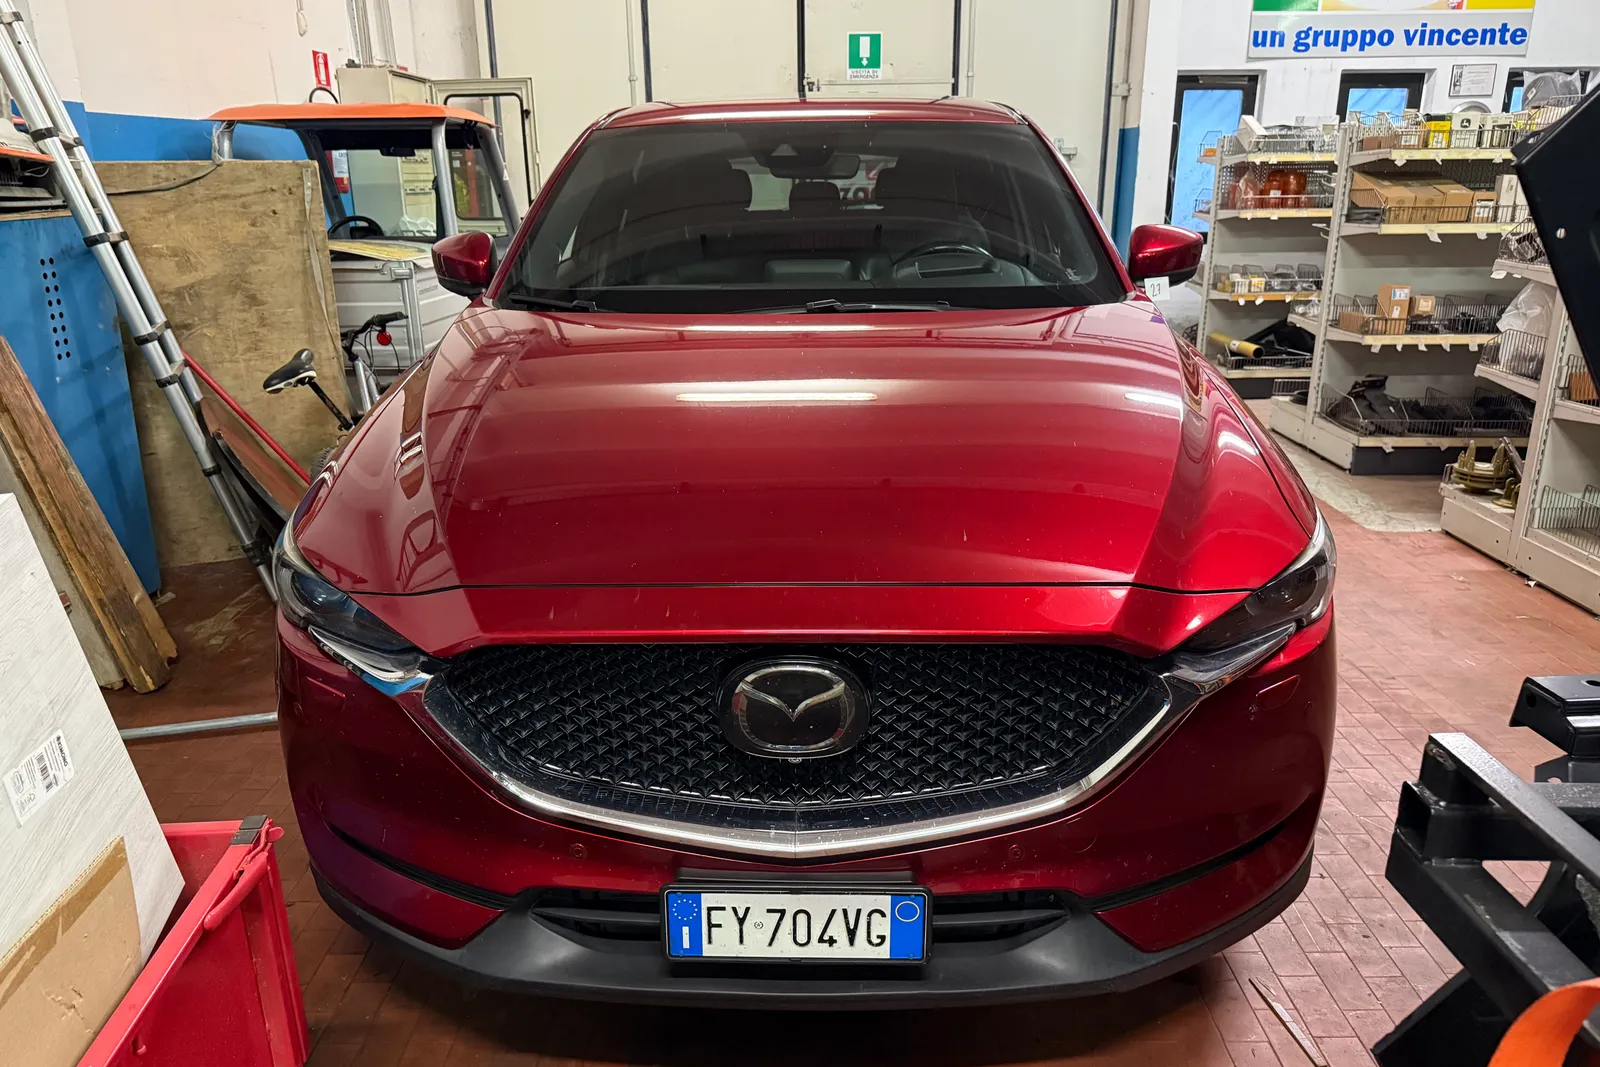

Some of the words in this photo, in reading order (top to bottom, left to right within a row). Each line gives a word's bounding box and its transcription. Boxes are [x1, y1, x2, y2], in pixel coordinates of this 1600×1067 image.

[1252, 29, 1286, 48] un
[1292, 25, 1395, 53] gruppo
[1403, 22, 1528, 47] vincente
[706, 906, 751, 945] FY
[766, 908, 887, 948] 704VG
